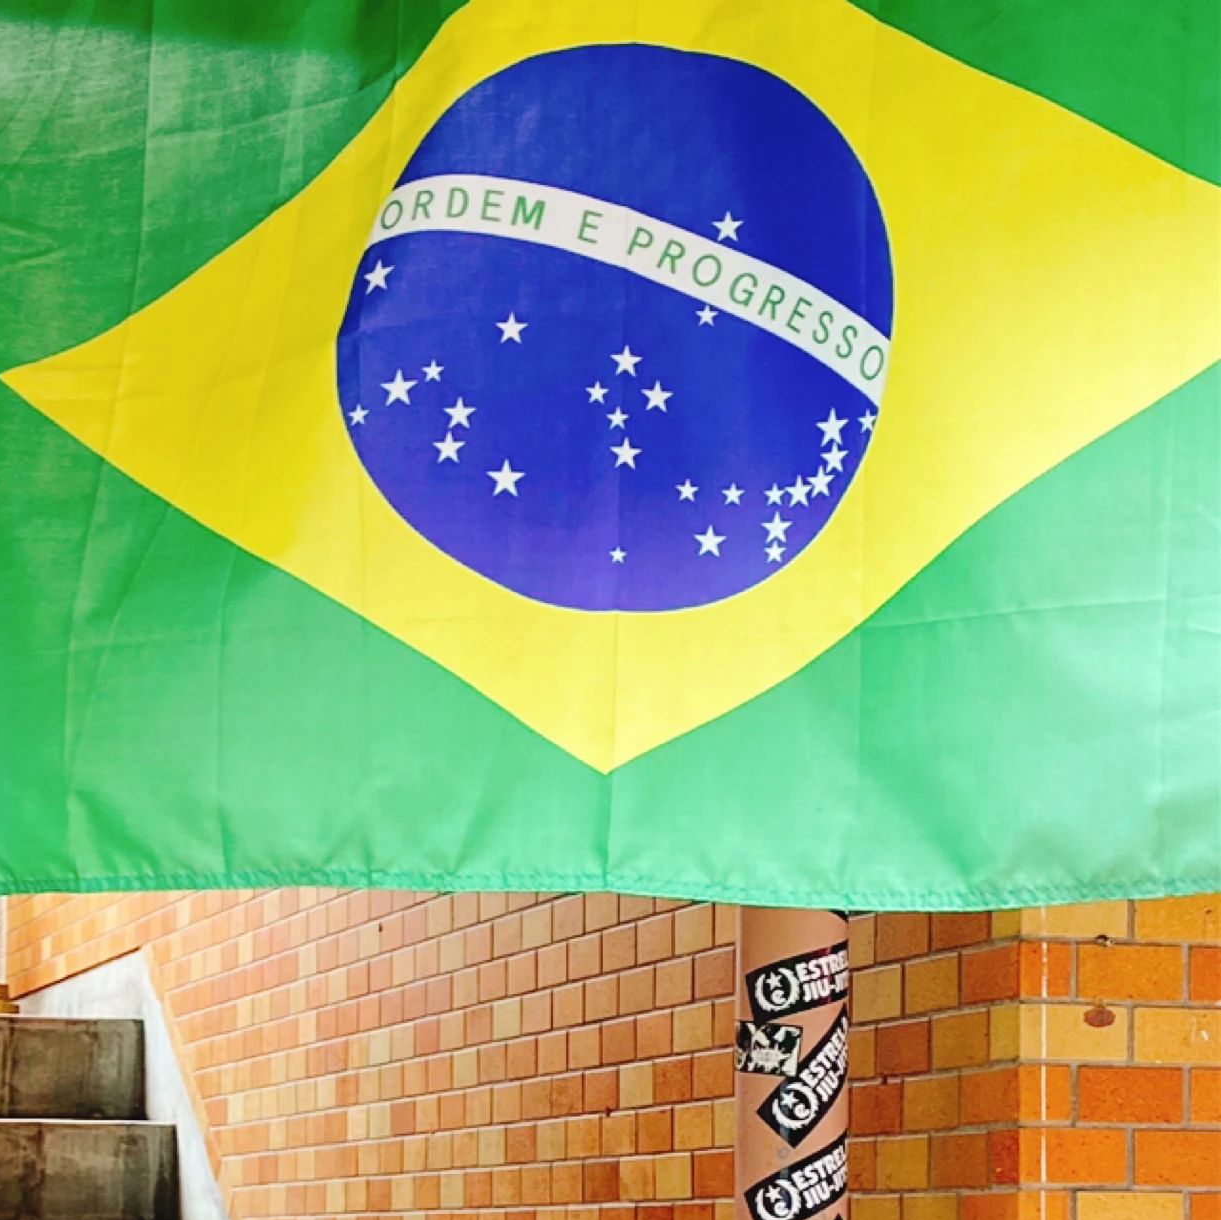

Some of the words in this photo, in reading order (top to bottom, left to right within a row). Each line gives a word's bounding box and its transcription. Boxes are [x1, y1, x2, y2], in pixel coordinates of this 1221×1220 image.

[380, 187, 546, 230] ORDEM
[578, 210, 603, 244] E
[627, 227, 884, 382] PROGRESSO
